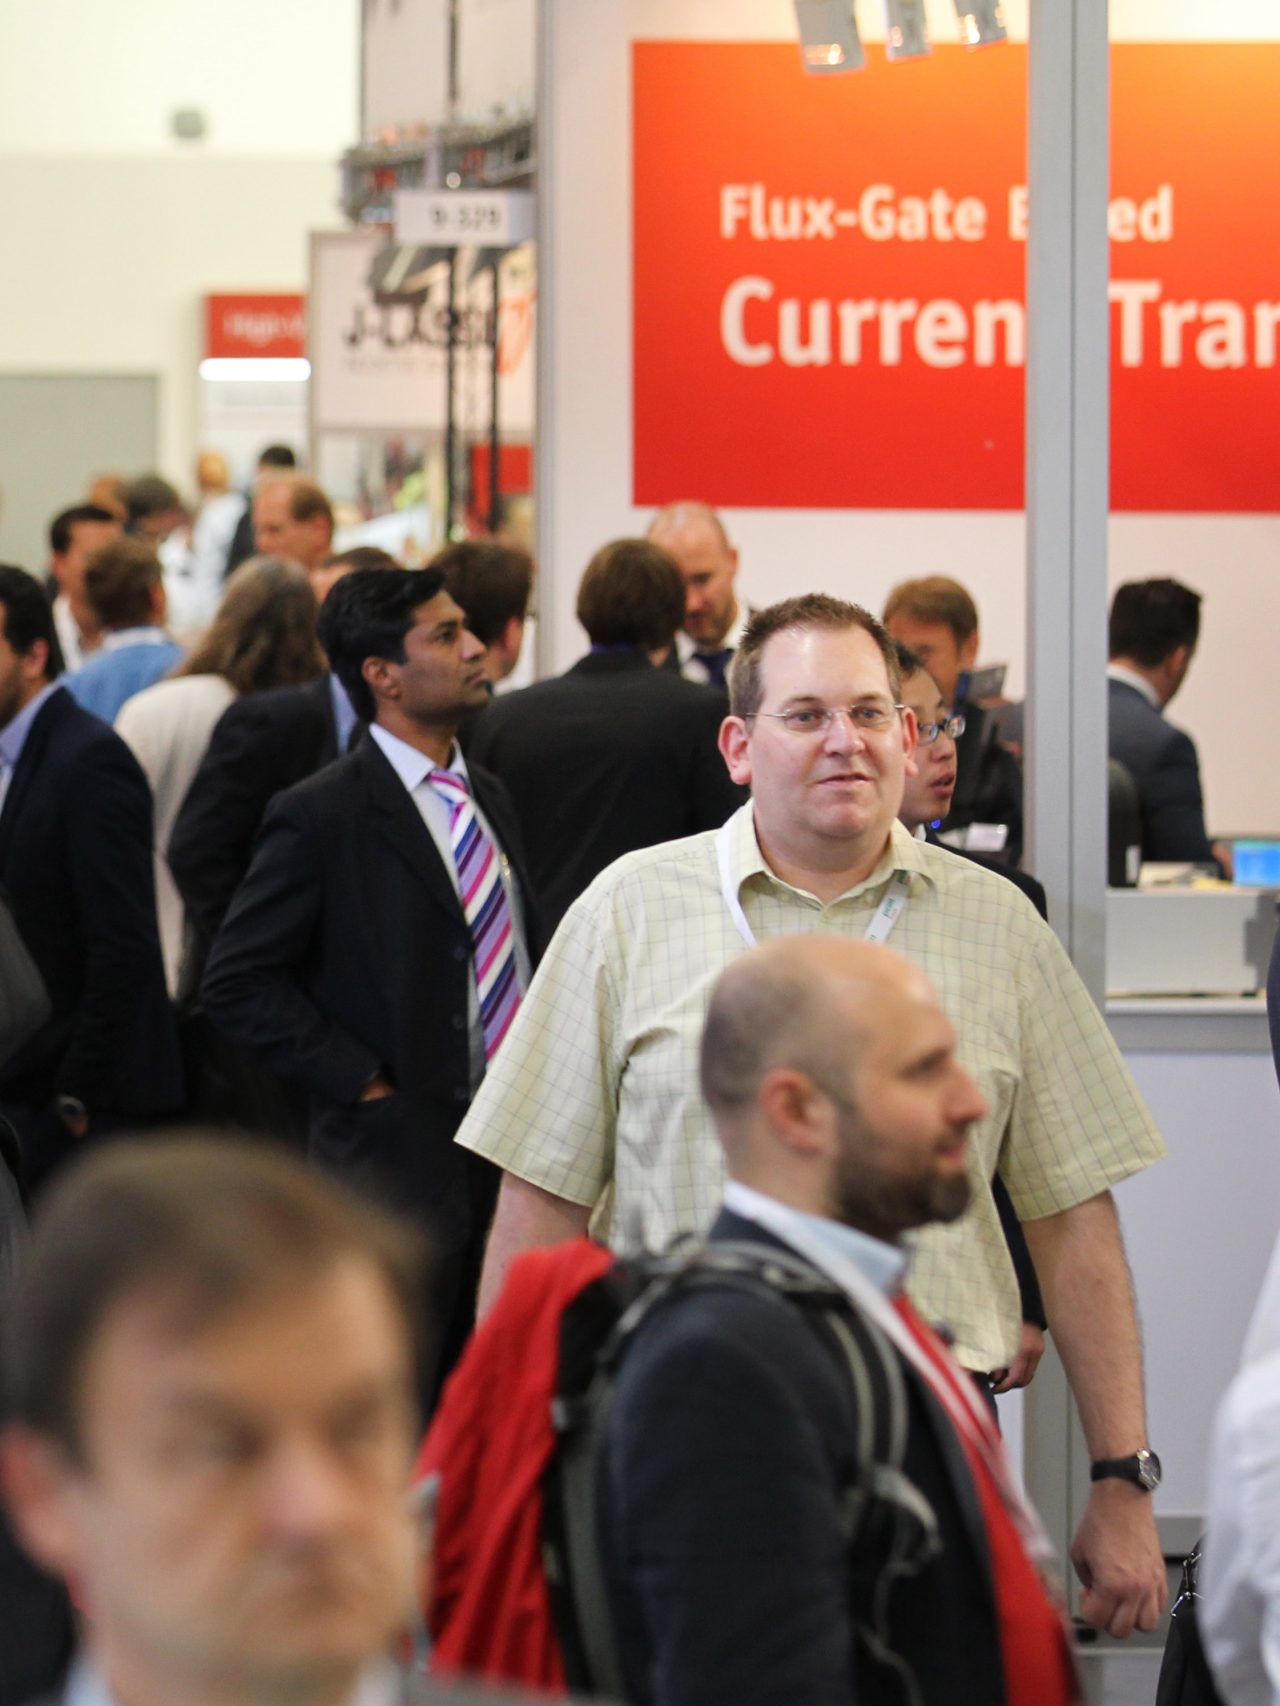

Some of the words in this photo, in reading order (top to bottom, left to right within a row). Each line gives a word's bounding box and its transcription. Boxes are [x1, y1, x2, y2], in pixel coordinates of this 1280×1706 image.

[721, 183, 987, 241] Flux-Gate
[1009, 183, 1174, 241] Bed
[721, 275, 1026, 368] Curren
